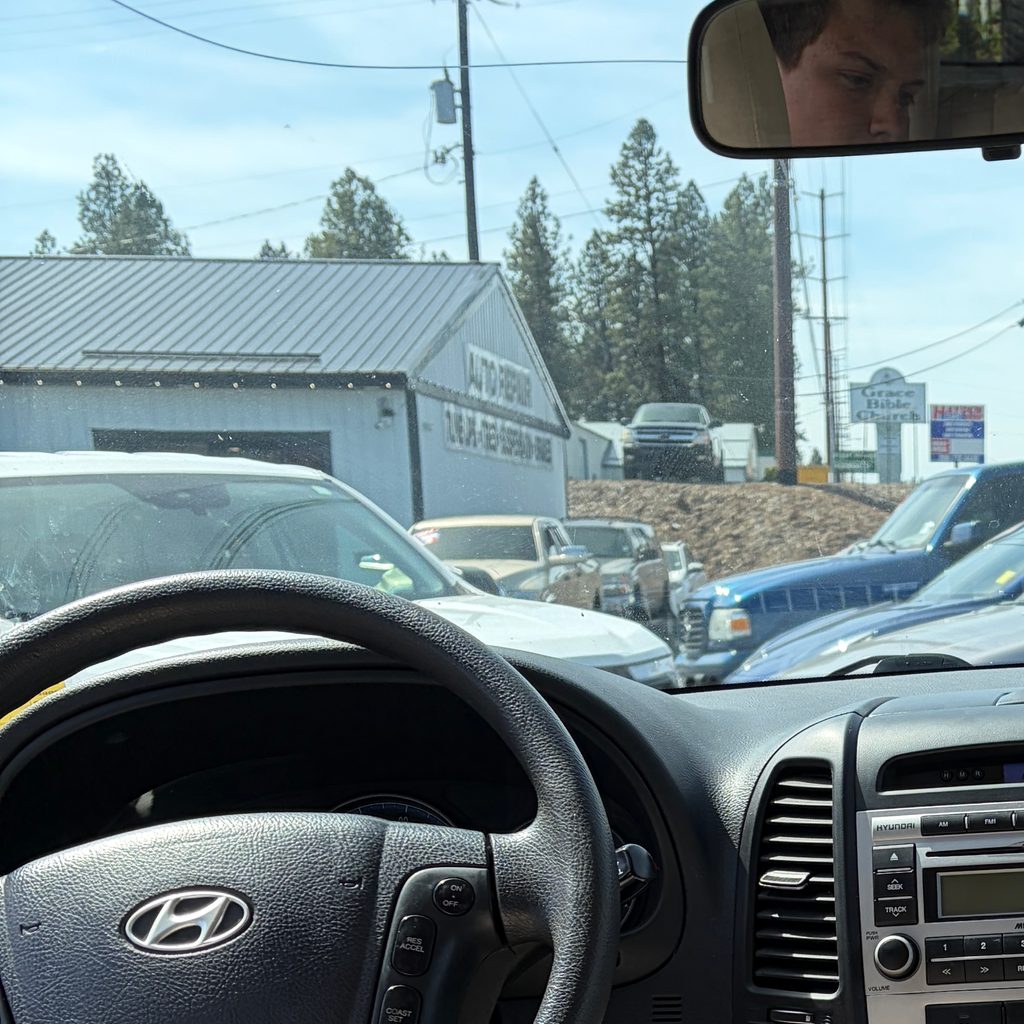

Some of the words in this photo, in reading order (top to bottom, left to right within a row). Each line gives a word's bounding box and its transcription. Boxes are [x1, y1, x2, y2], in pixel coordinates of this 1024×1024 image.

[861, 387, 915, 398] Grace
[866, 398, 911, 409] Bible
[856, 410, 920, 422] Church
[876, 821, 916, 831] HYUNDAI
[450, 884, 463, 892] ON
[887, 883, 903, 891] SEEK
[885, 905, 907, 914] TRACK
[406, 937, 422, 945] RES
[400, 942, 425, 953] ACCEL
[943, 943, 947, 951] 1
[980, 942, 987, 950] 2
[385, 1007, 412, 1017] COAST
[388, 1014, 403, 1023] SET
